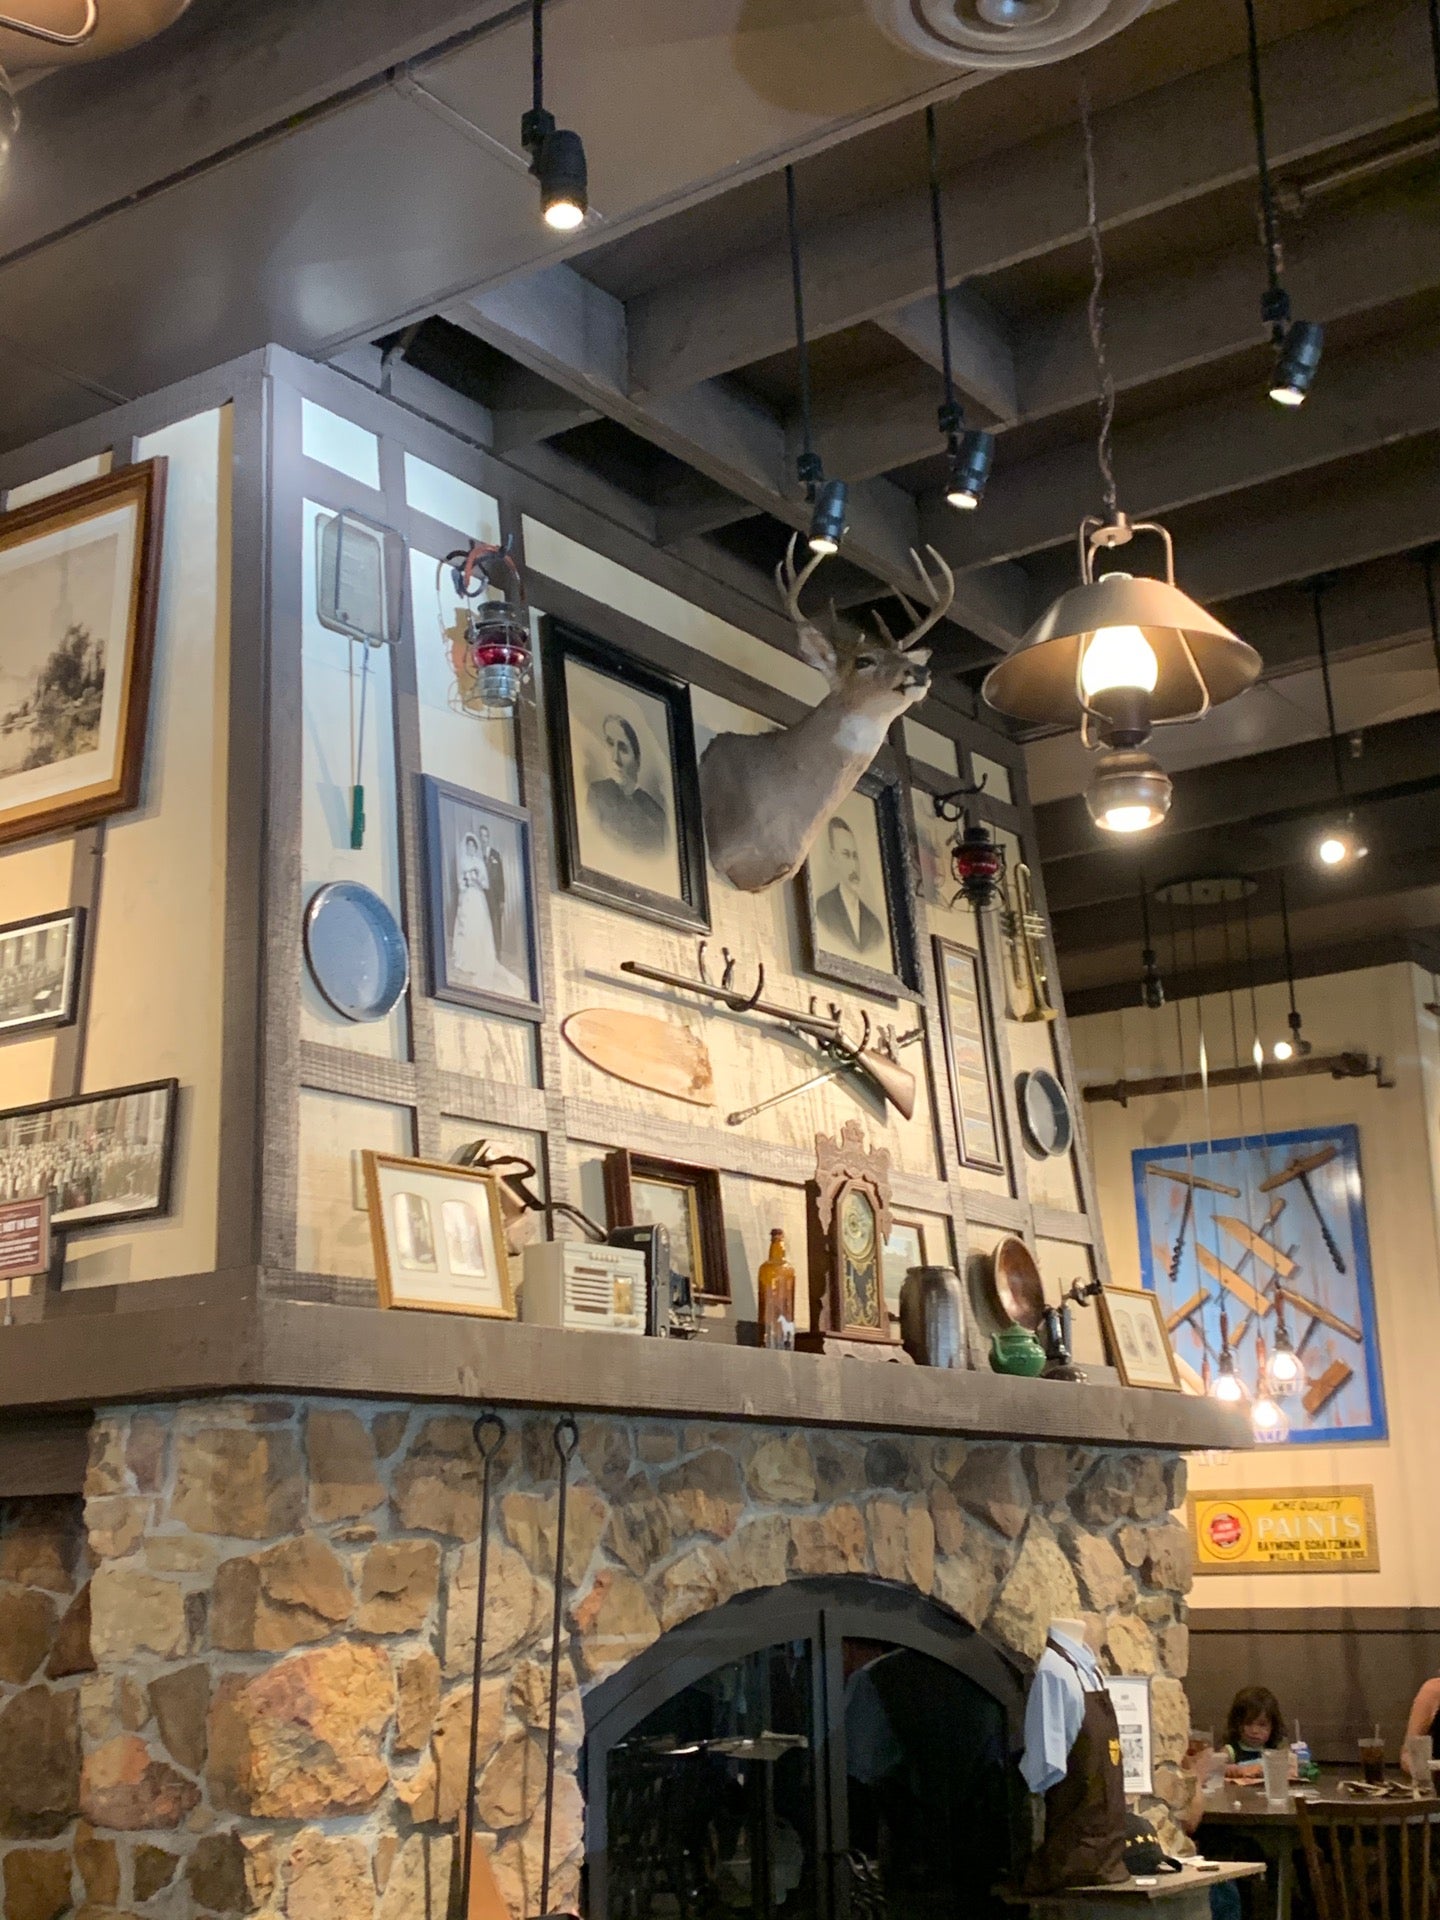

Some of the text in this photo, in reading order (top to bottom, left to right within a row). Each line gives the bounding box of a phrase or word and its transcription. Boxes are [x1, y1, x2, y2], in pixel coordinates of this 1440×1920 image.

[1299, 1500, 1342, 1512] QUALITY
[1256, 1514, 1362, 1539] PAINTS
[1257, 1540, 1301, 1552] RAYMOND
